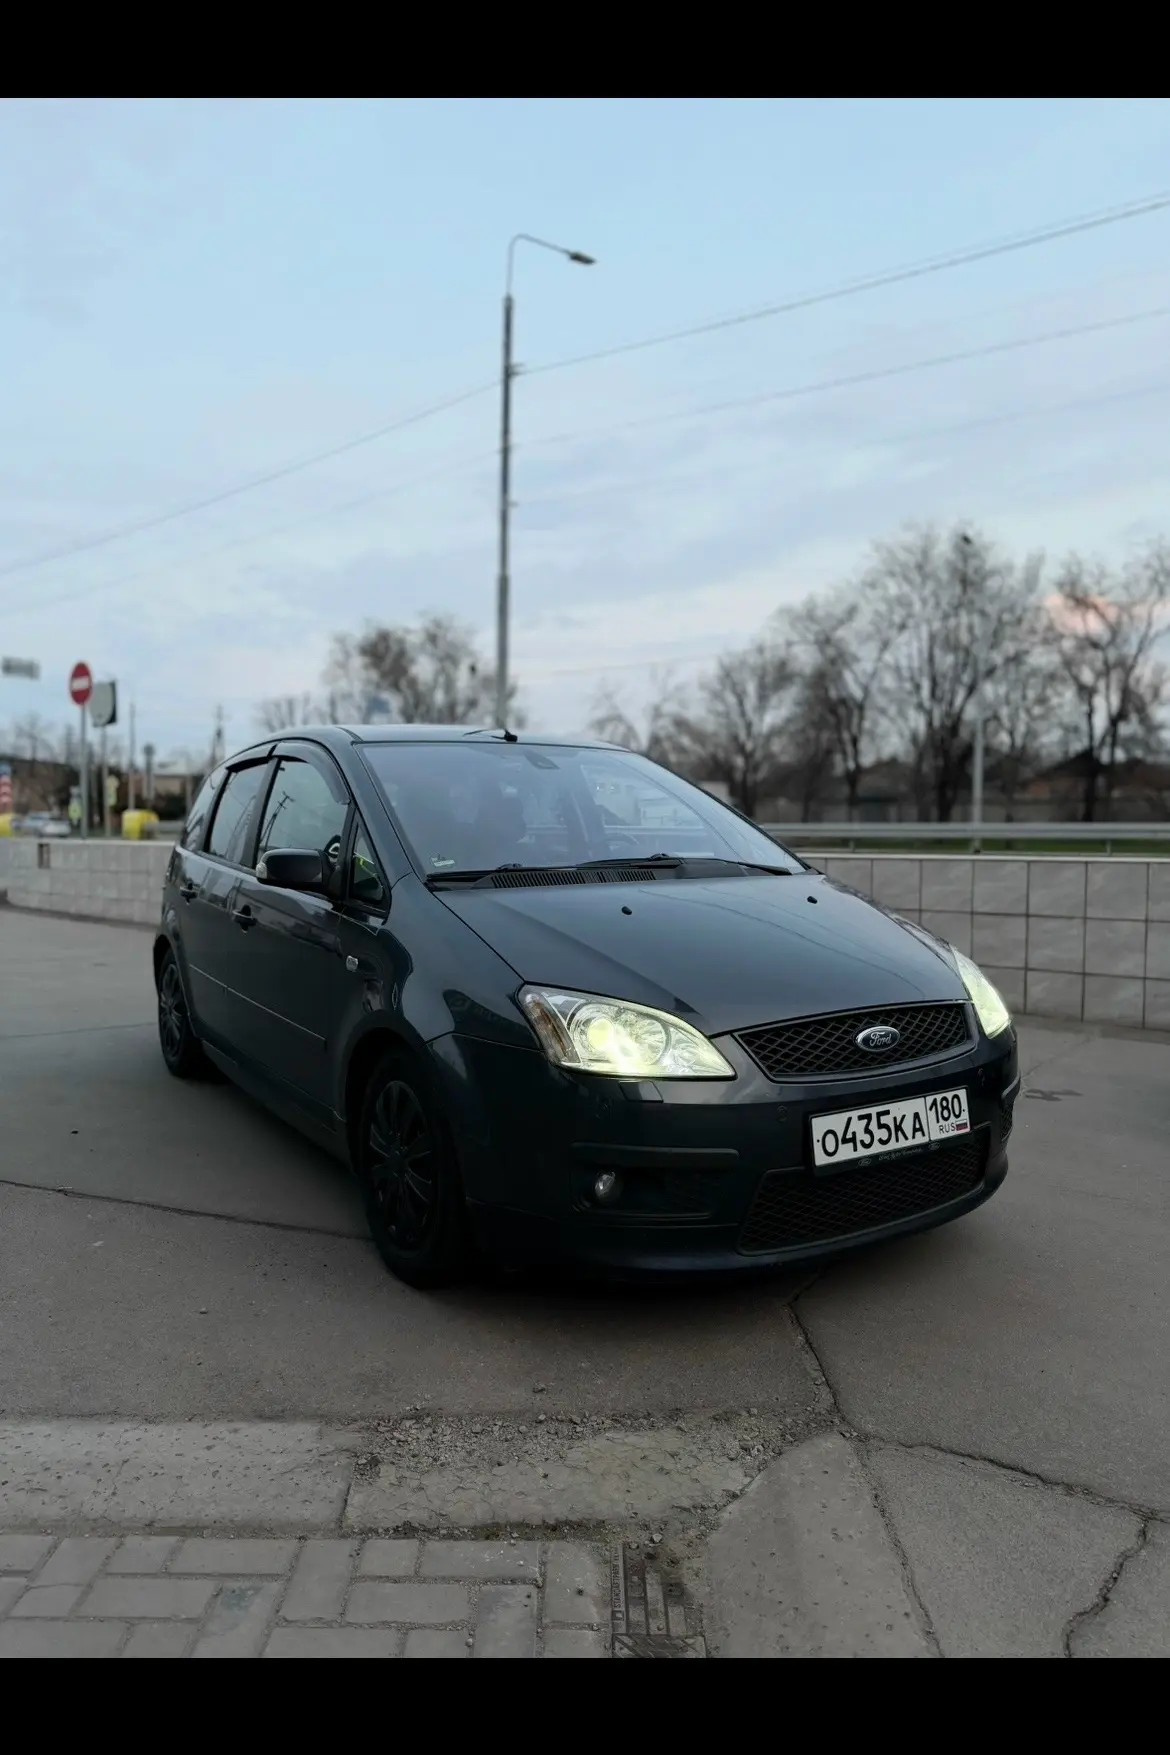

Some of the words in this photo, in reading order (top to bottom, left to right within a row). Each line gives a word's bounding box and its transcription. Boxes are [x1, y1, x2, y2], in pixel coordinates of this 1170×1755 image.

[869, 1031, 892, 1047] Ford
[929, 1093, 962, 1124] 180
[938, 1122, 956, 1135] RUS
